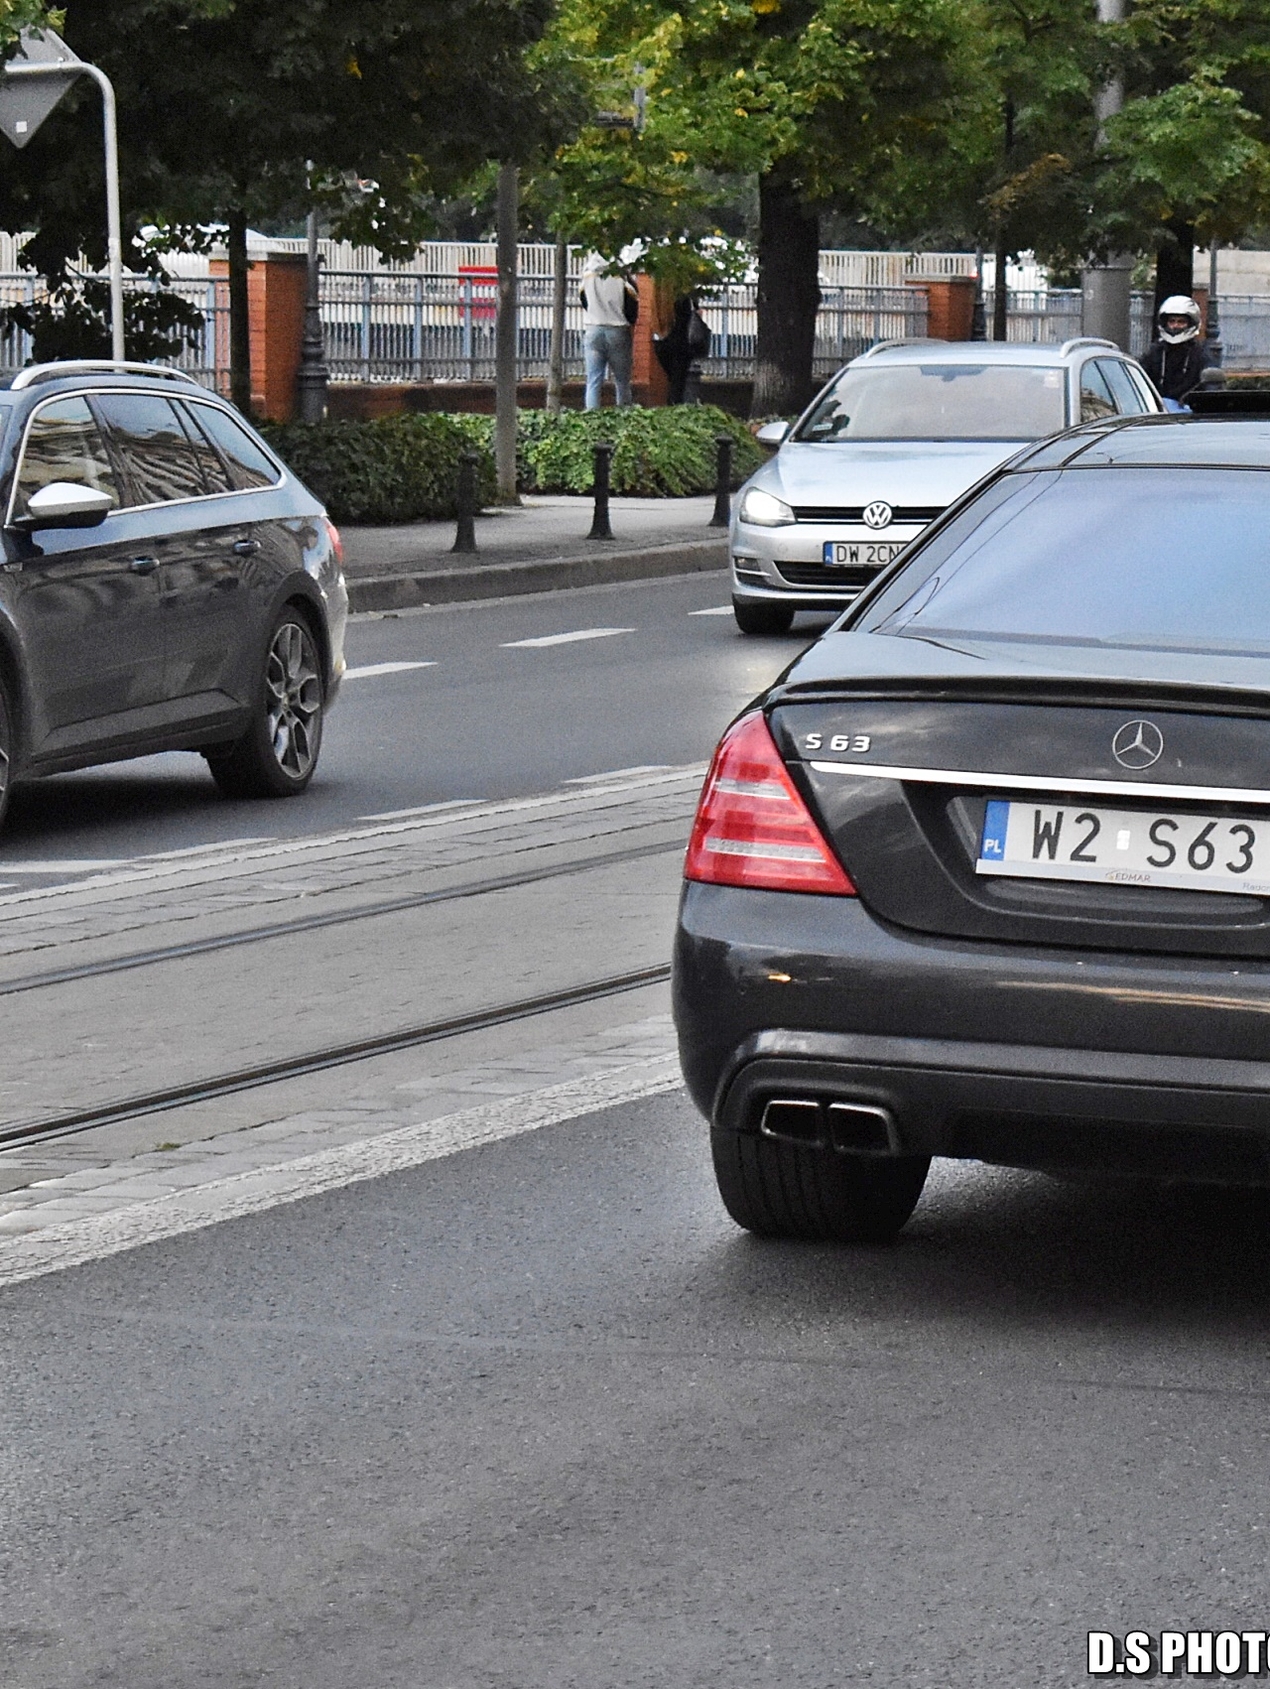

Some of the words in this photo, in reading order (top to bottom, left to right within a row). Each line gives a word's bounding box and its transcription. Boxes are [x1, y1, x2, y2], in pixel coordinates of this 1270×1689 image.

[836, 545, 859, 563] DW
[866, 545, 907, 563] 2CN
[805, 733, 822, 749] S
[830, 735, 870, 752] 63
[984, 839, 1002, 853] PL
[1032, 809, 1101, 863] W2
[1146, 818, 1256, 875] S63
